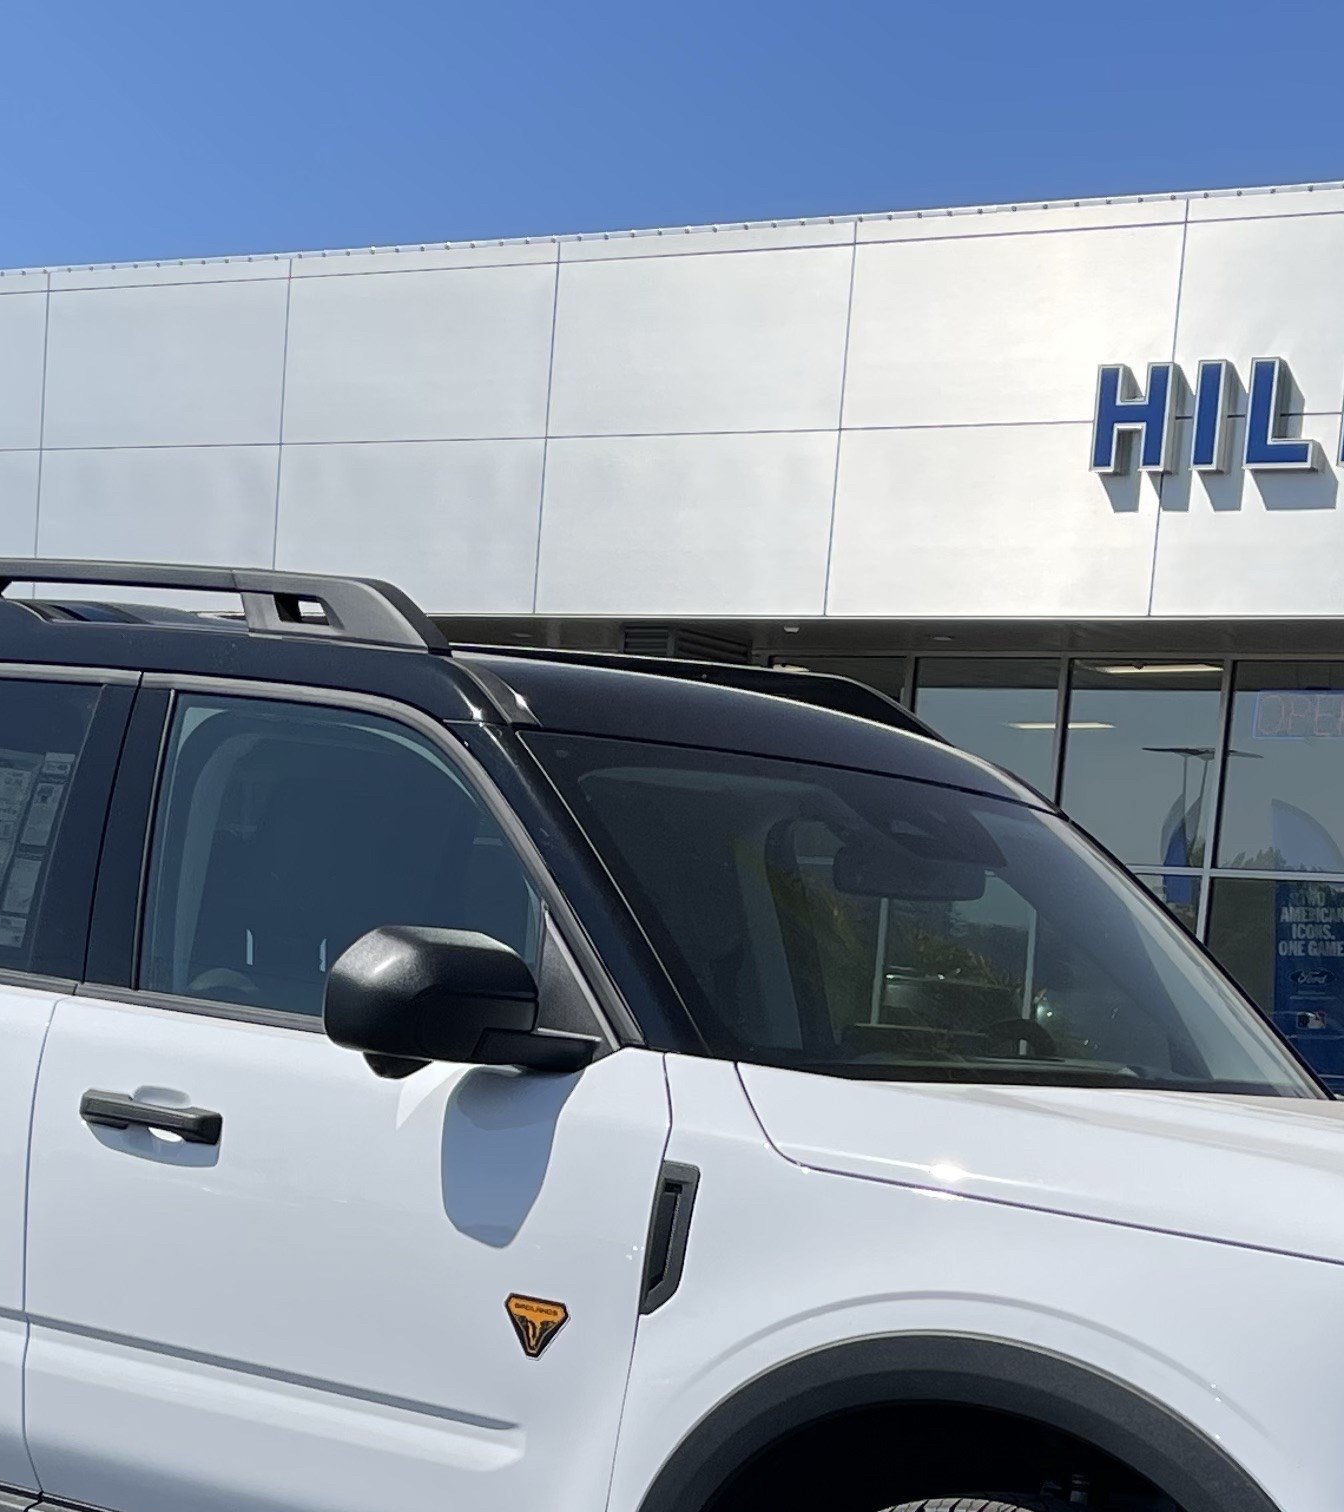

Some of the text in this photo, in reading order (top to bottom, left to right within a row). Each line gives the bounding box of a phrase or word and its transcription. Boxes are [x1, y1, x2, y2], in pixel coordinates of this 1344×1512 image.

[1291, 923, 1336, 940] ICONS.
[1278, 940, 1305, 956] ONE
[1297, 969, 1328, 984] Ford
